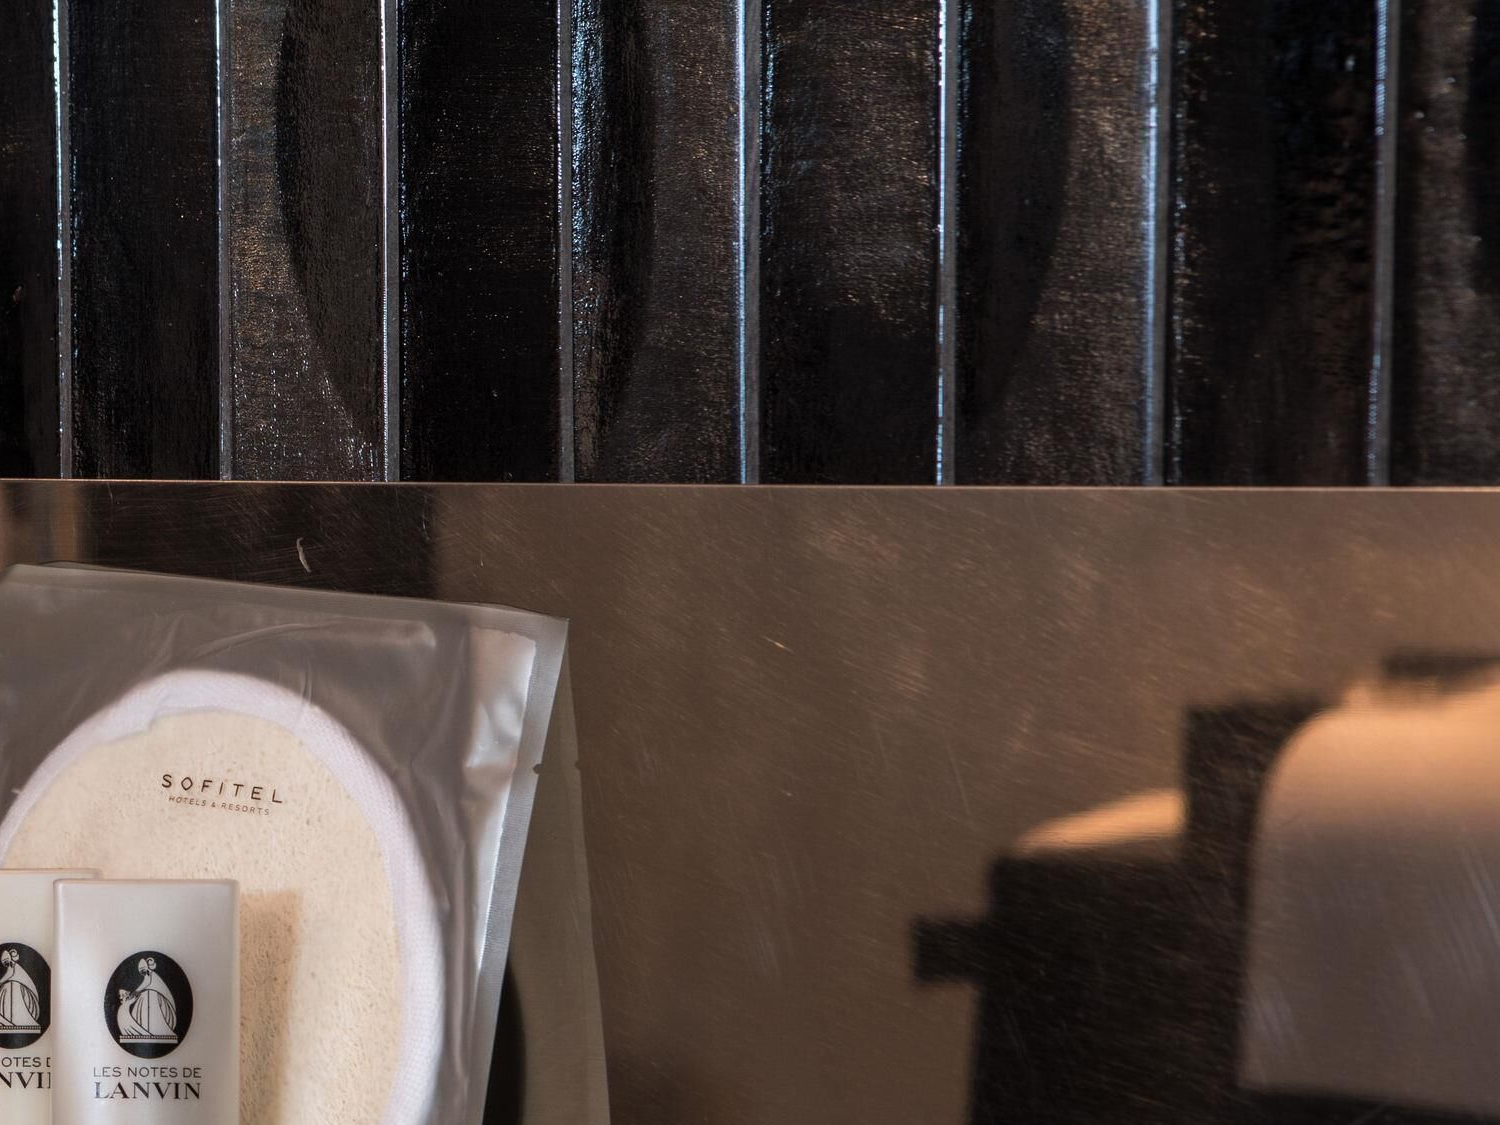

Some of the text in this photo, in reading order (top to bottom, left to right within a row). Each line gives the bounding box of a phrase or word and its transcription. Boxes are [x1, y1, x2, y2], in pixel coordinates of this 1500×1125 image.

[161, 774, 283, 804] SOFITEL
[168, 796, 206, 808] HOTELS
[222, 802, 270, 816] RESORTS
[94, 1066, 202, 1078] LES NOTES DE
[94, 1082, 202, 1100] LANVIN
